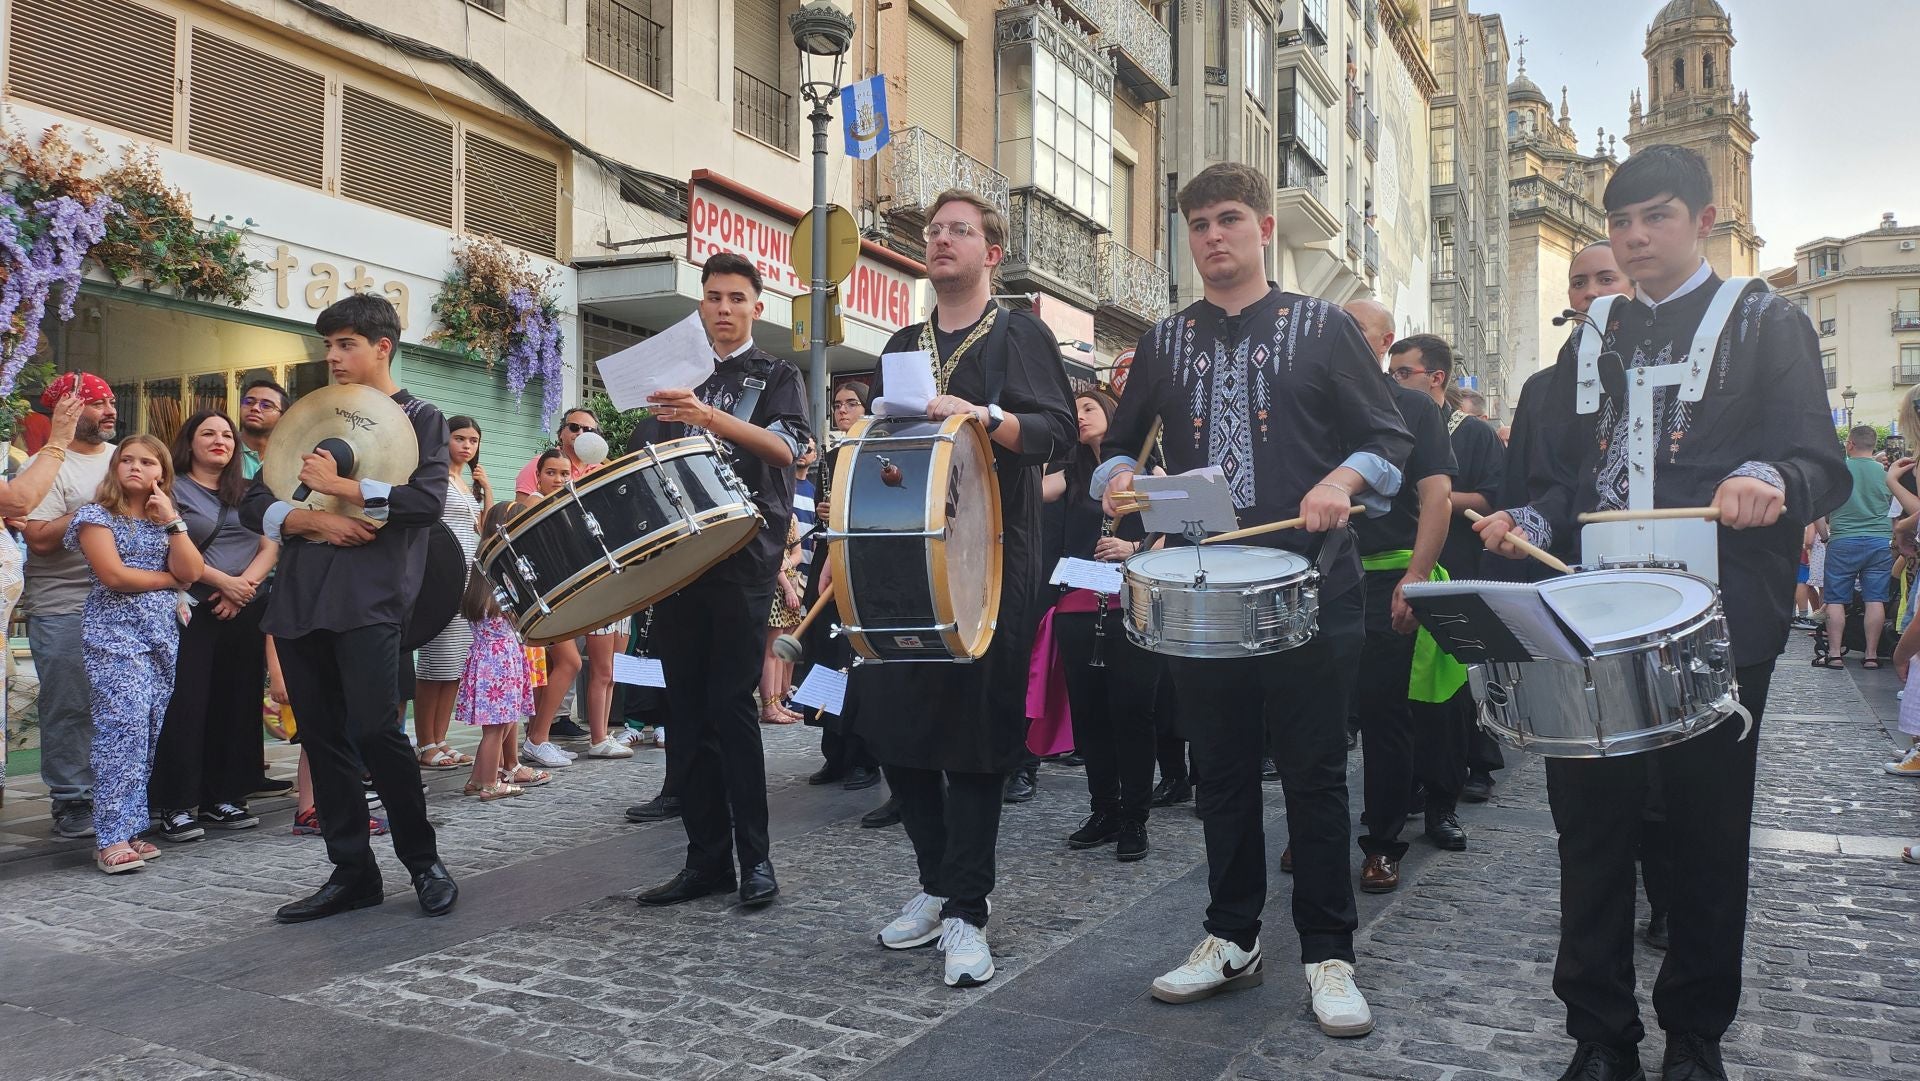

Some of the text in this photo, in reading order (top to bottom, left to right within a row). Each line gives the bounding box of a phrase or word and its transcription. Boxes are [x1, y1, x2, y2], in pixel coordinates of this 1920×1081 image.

[693, 197, 793, 267] OPORTUNI
[266, 244, 409, 330] tata
[756, 260, 780, 282] EN
[846, 264, 910, 328] JAVIER
